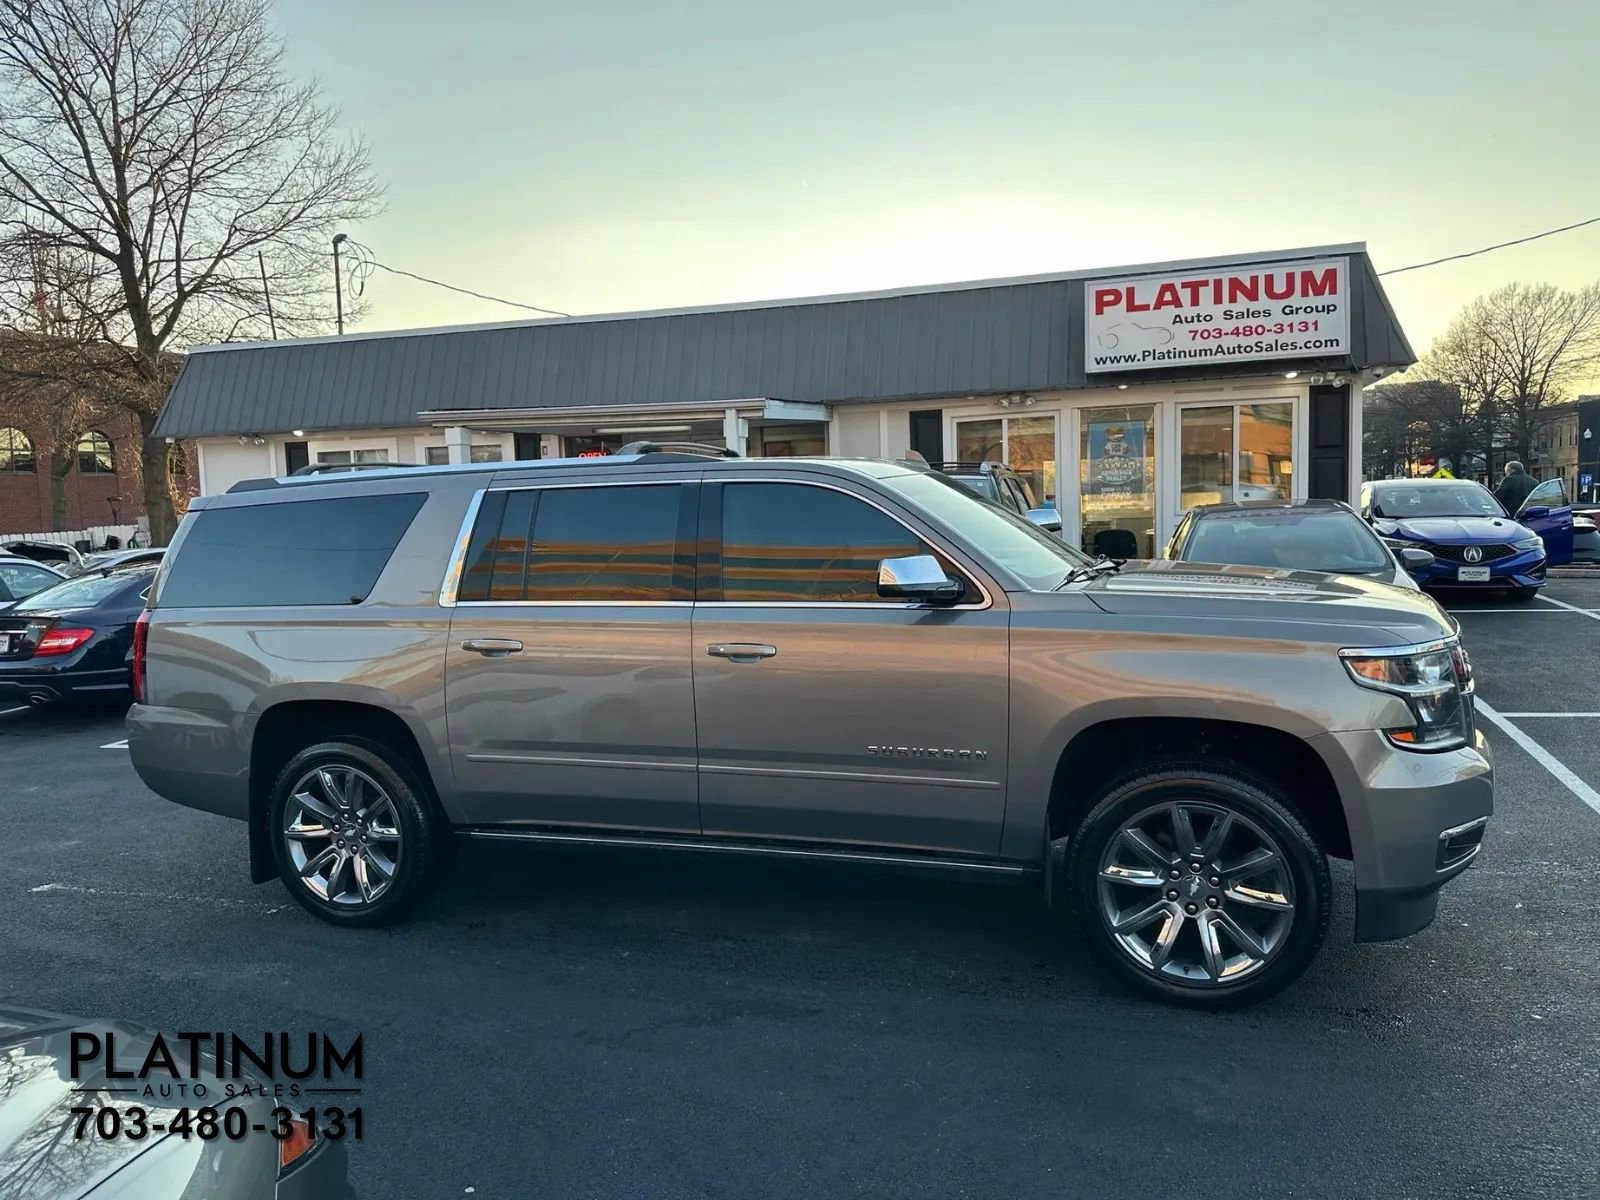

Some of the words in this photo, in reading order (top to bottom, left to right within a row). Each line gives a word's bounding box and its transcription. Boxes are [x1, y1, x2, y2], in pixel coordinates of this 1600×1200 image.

[1095, 267, 1338, 316] PLATINUM
[1172, 312, 1213, 325] Auto
[1223, 308, 1272, 321] Sales
[1281, 302, 1338, 318] Group
[1188, 320, 1320, 341] 703-480-3131
[1094, 336, 1340, 366] www.PlatinumAutoSales.com
[867, 746, 988, 760] SUBURBAN
